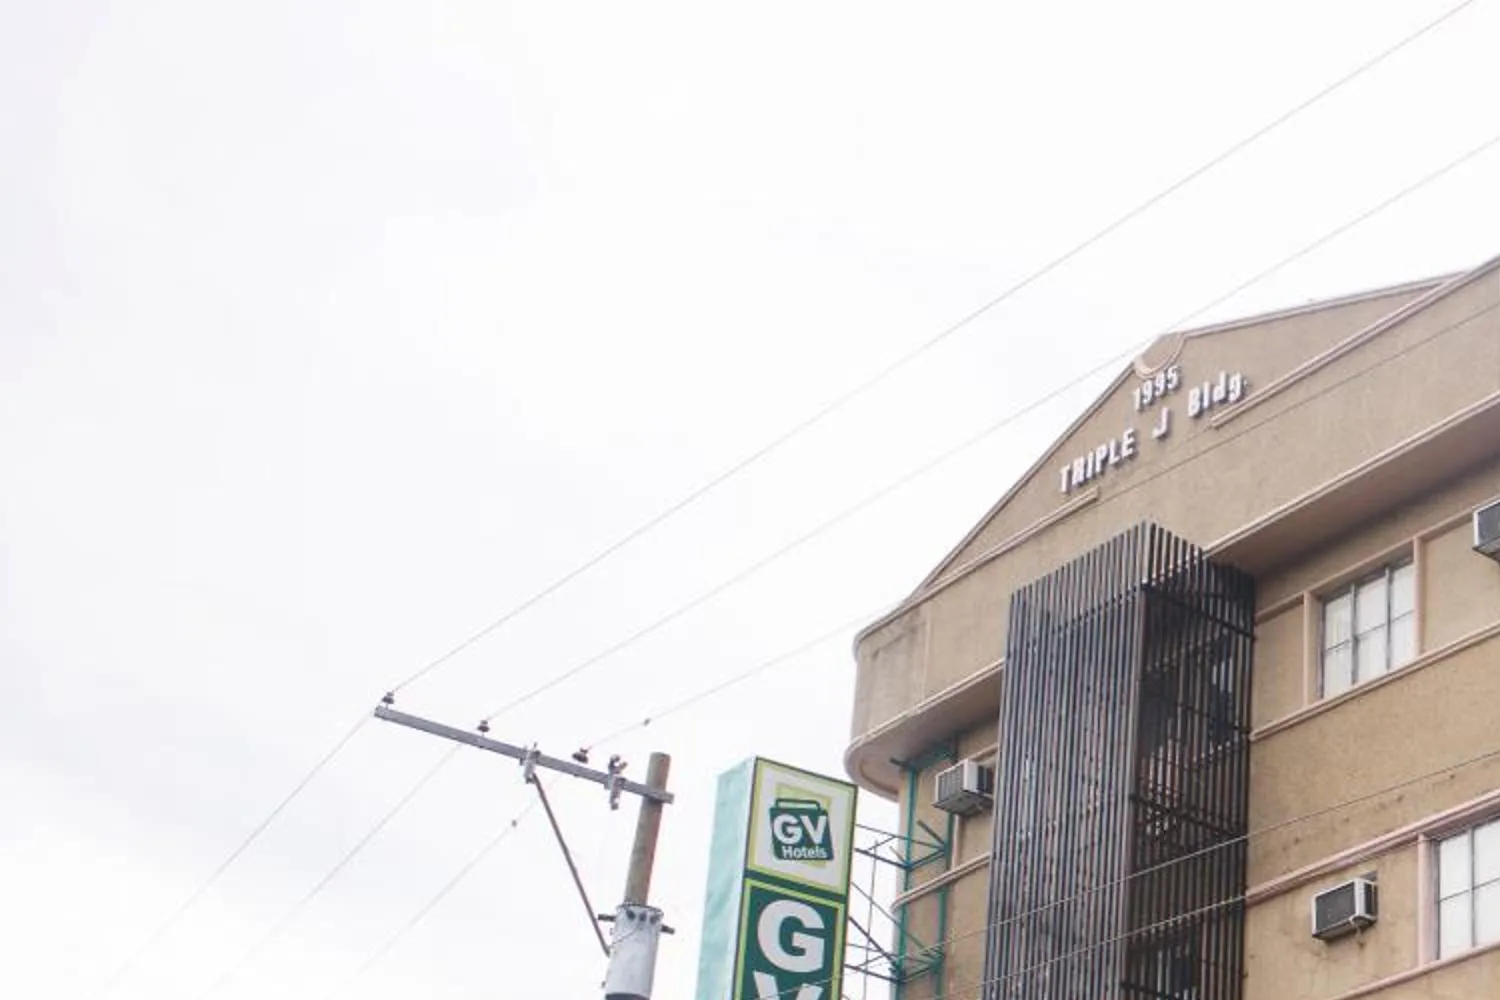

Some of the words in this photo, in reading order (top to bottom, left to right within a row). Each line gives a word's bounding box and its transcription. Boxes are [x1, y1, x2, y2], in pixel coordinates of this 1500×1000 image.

[1132, 365, 1182, 412] 1995
[1059, 427, 1137, 493] TRIPLE
[1152, 407, 1170, 439] J
[773, 813, 827, 846] GV
[781, 844, 828, 860] Hotels
